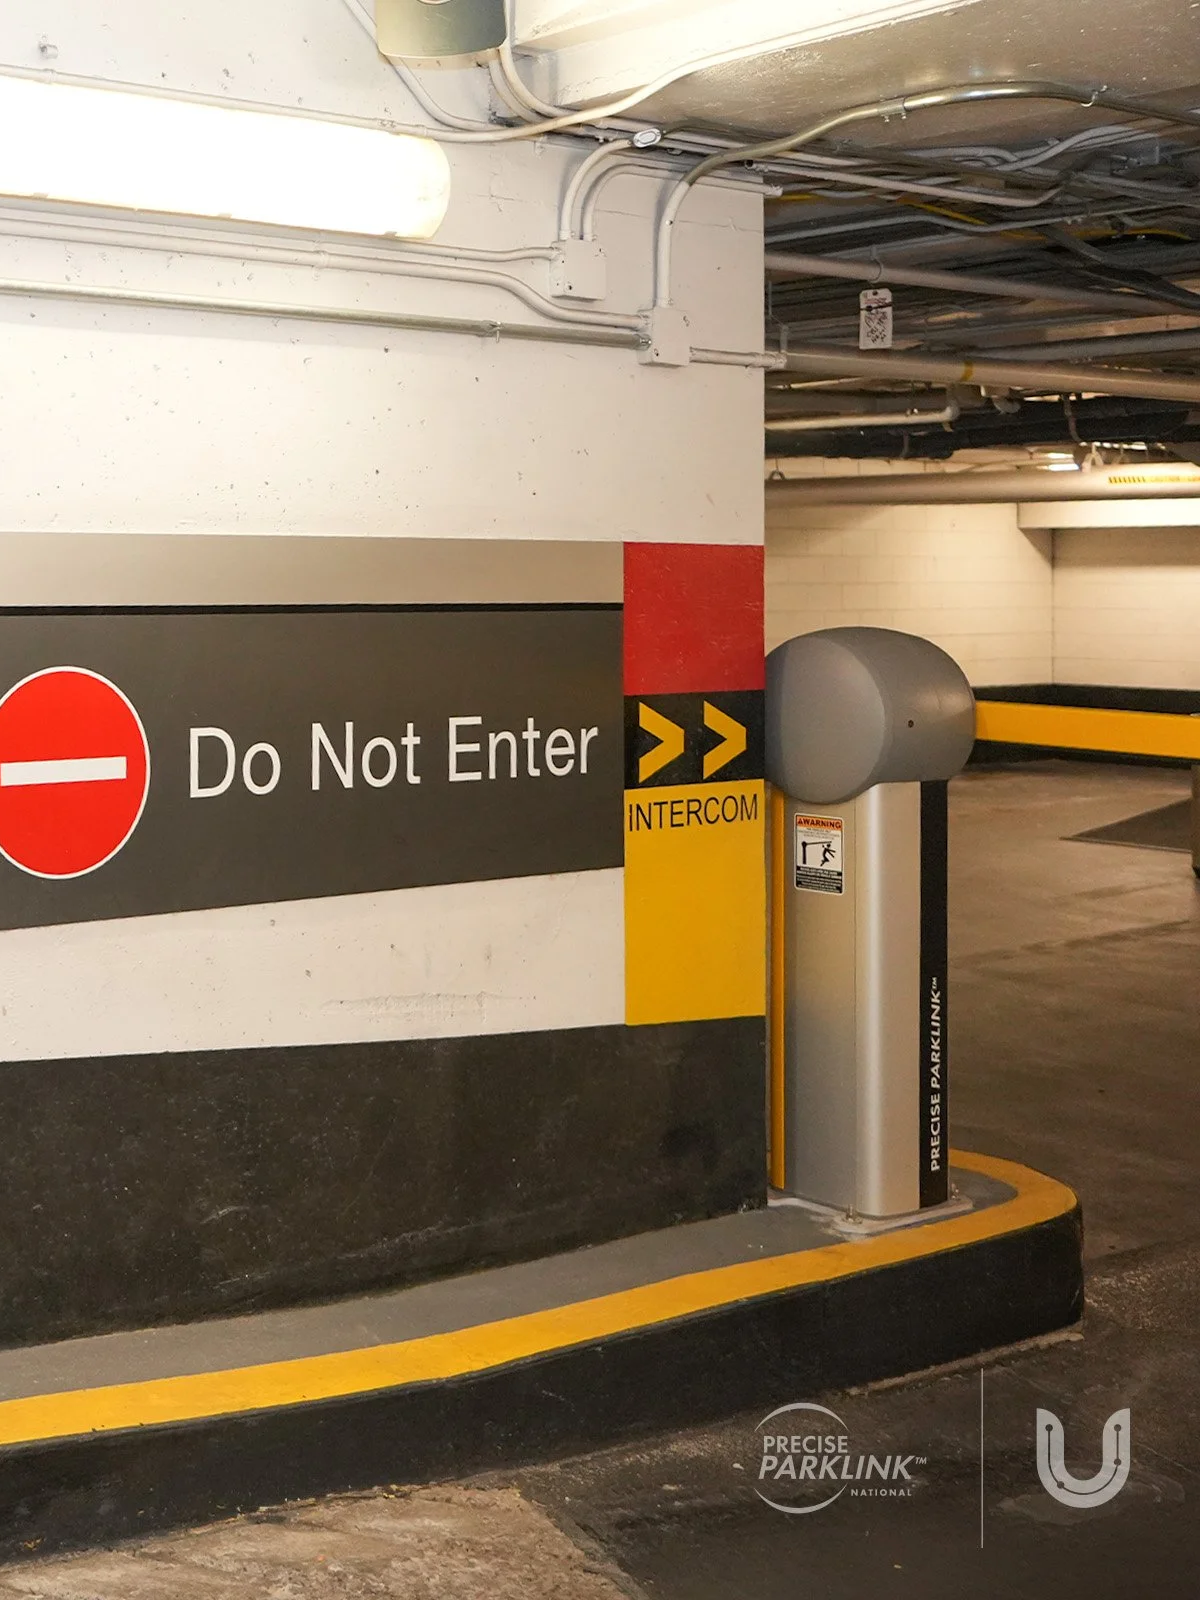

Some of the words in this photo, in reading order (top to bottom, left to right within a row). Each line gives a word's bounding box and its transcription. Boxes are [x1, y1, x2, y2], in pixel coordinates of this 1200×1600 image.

[188, 726, 282, 799] Do
[311, 720, 422, 791] Not
[447, 715, 600, 783] Enter
[628, 794, 759, 832] INTERCOM
[802, 819, 842, 829] WARNING
[930, 1092, 941, 1172] PRECISE
